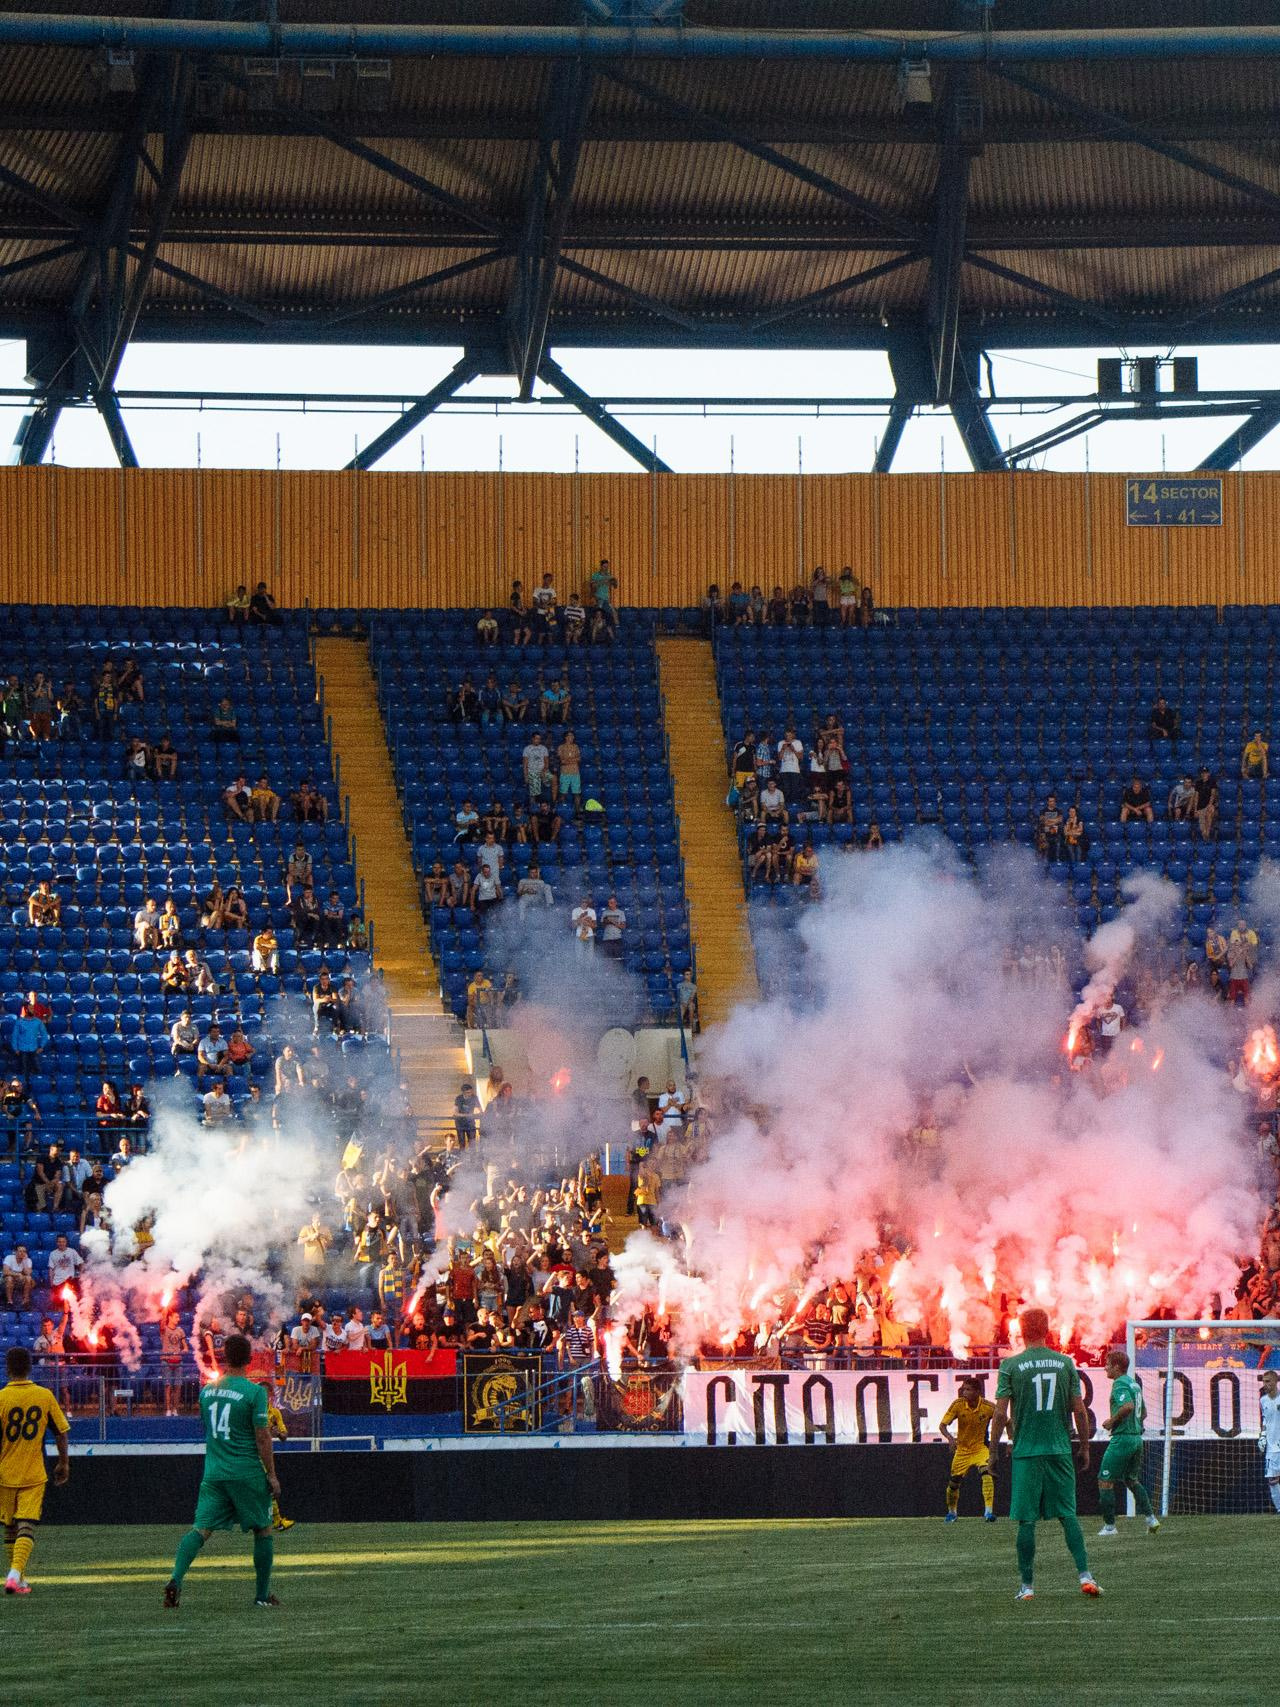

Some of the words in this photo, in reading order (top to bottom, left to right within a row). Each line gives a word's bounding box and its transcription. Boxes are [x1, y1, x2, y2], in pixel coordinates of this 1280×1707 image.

[1129, 482, 1158, 504] 14
[1161, 487, 1218, 499] SECTOR
[1153, 509, 1160, 523] 1
[1178, 508, 1196, 523] 41
[1031, 1372, 1057, 1411] 17
[6, 1405, 42, 1442] 88
[208, 1401, 231, 1440] 14
